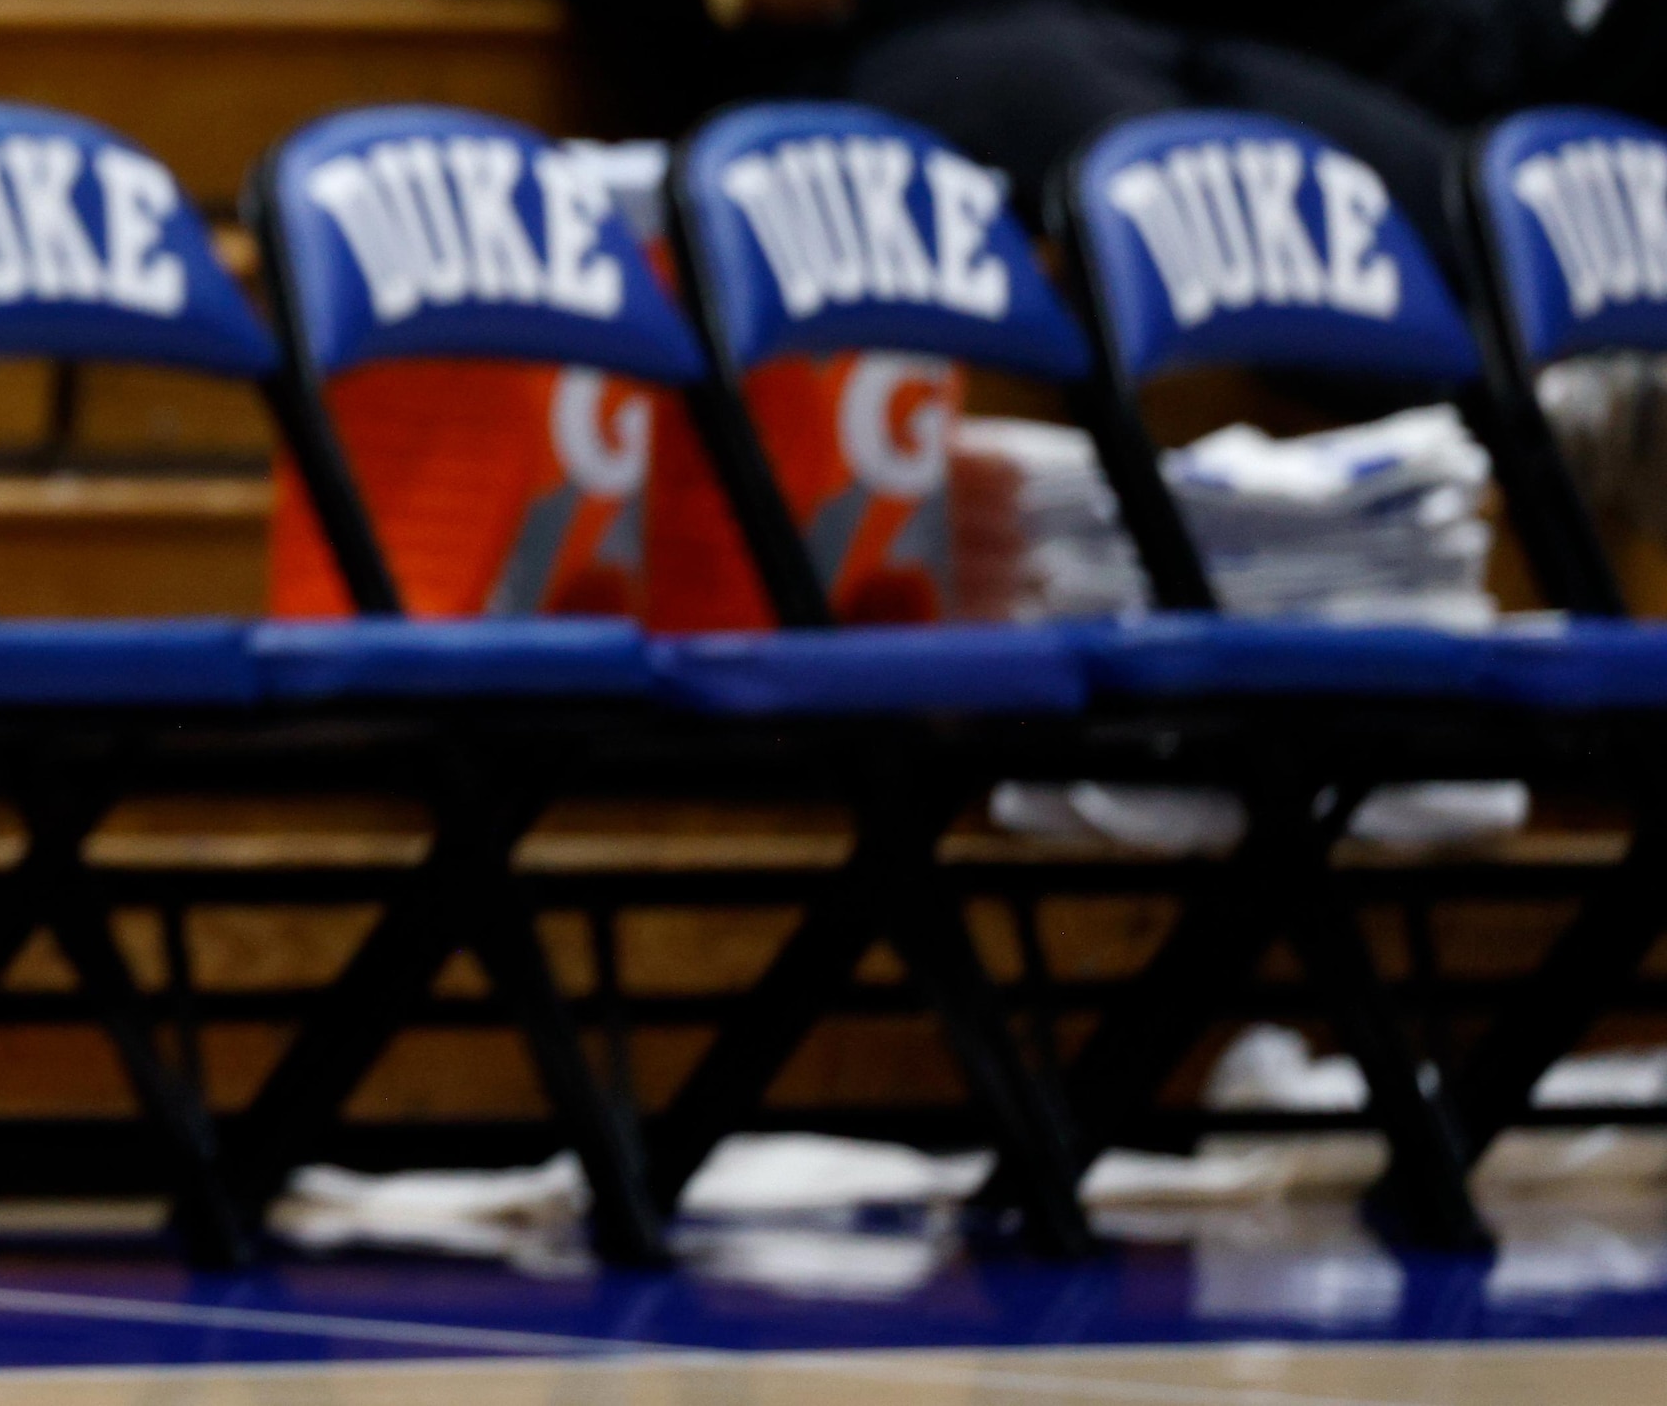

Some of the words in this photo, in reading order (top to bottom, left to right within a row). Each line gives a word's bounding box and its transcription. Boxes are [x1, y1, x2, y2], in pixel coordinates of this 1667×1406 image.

[305, 137, 625, 322] DUKE
[720, 137, 1011, 321] DUKE
[1107, 140, 1402, 325] DUKE
[1515, 138, 1667, 320] DUK
